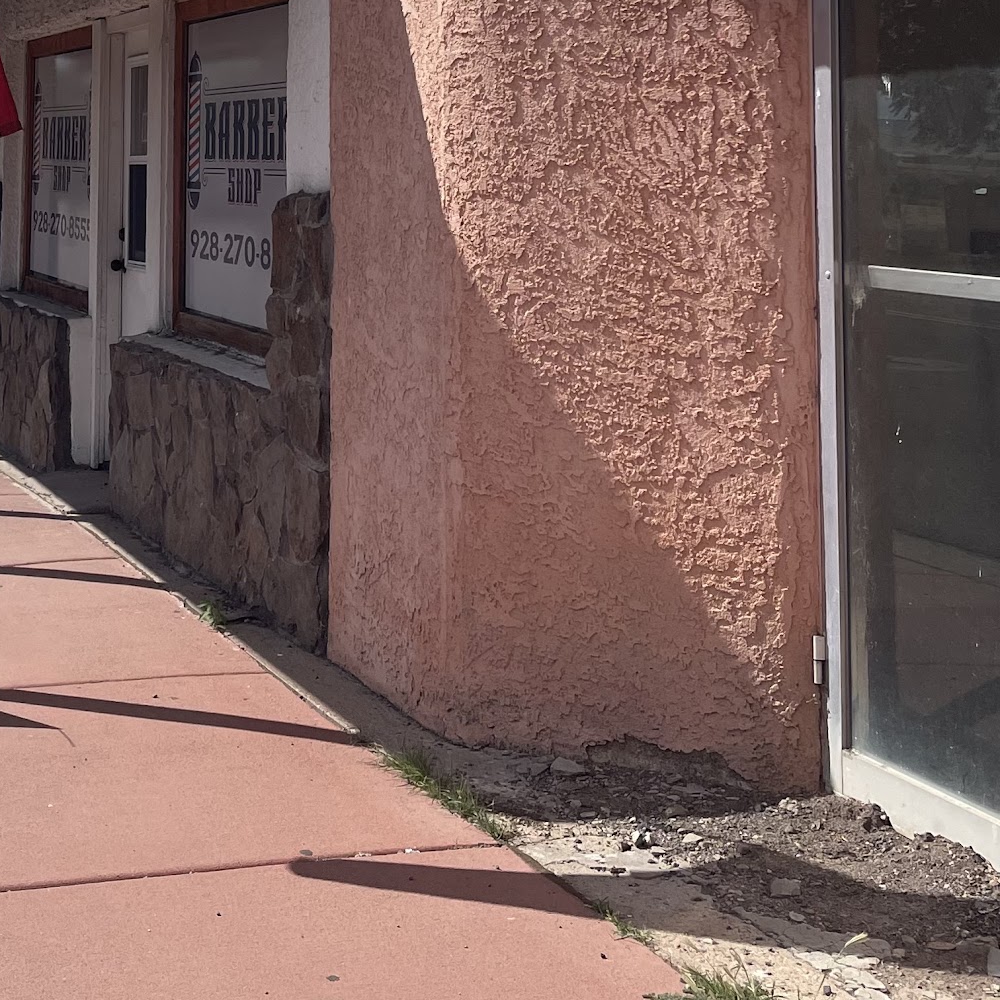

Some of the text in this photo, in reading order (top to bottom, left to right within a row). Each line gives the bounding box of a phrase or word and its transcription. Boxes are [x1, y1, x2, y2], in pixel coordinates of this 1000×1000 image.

[42, 115, 87, 161] BARBER
[204, 96, 287, 162] BARBER
[53, 165, 71, 192] SHOP
[227, 167, 262, 206] SHOP
